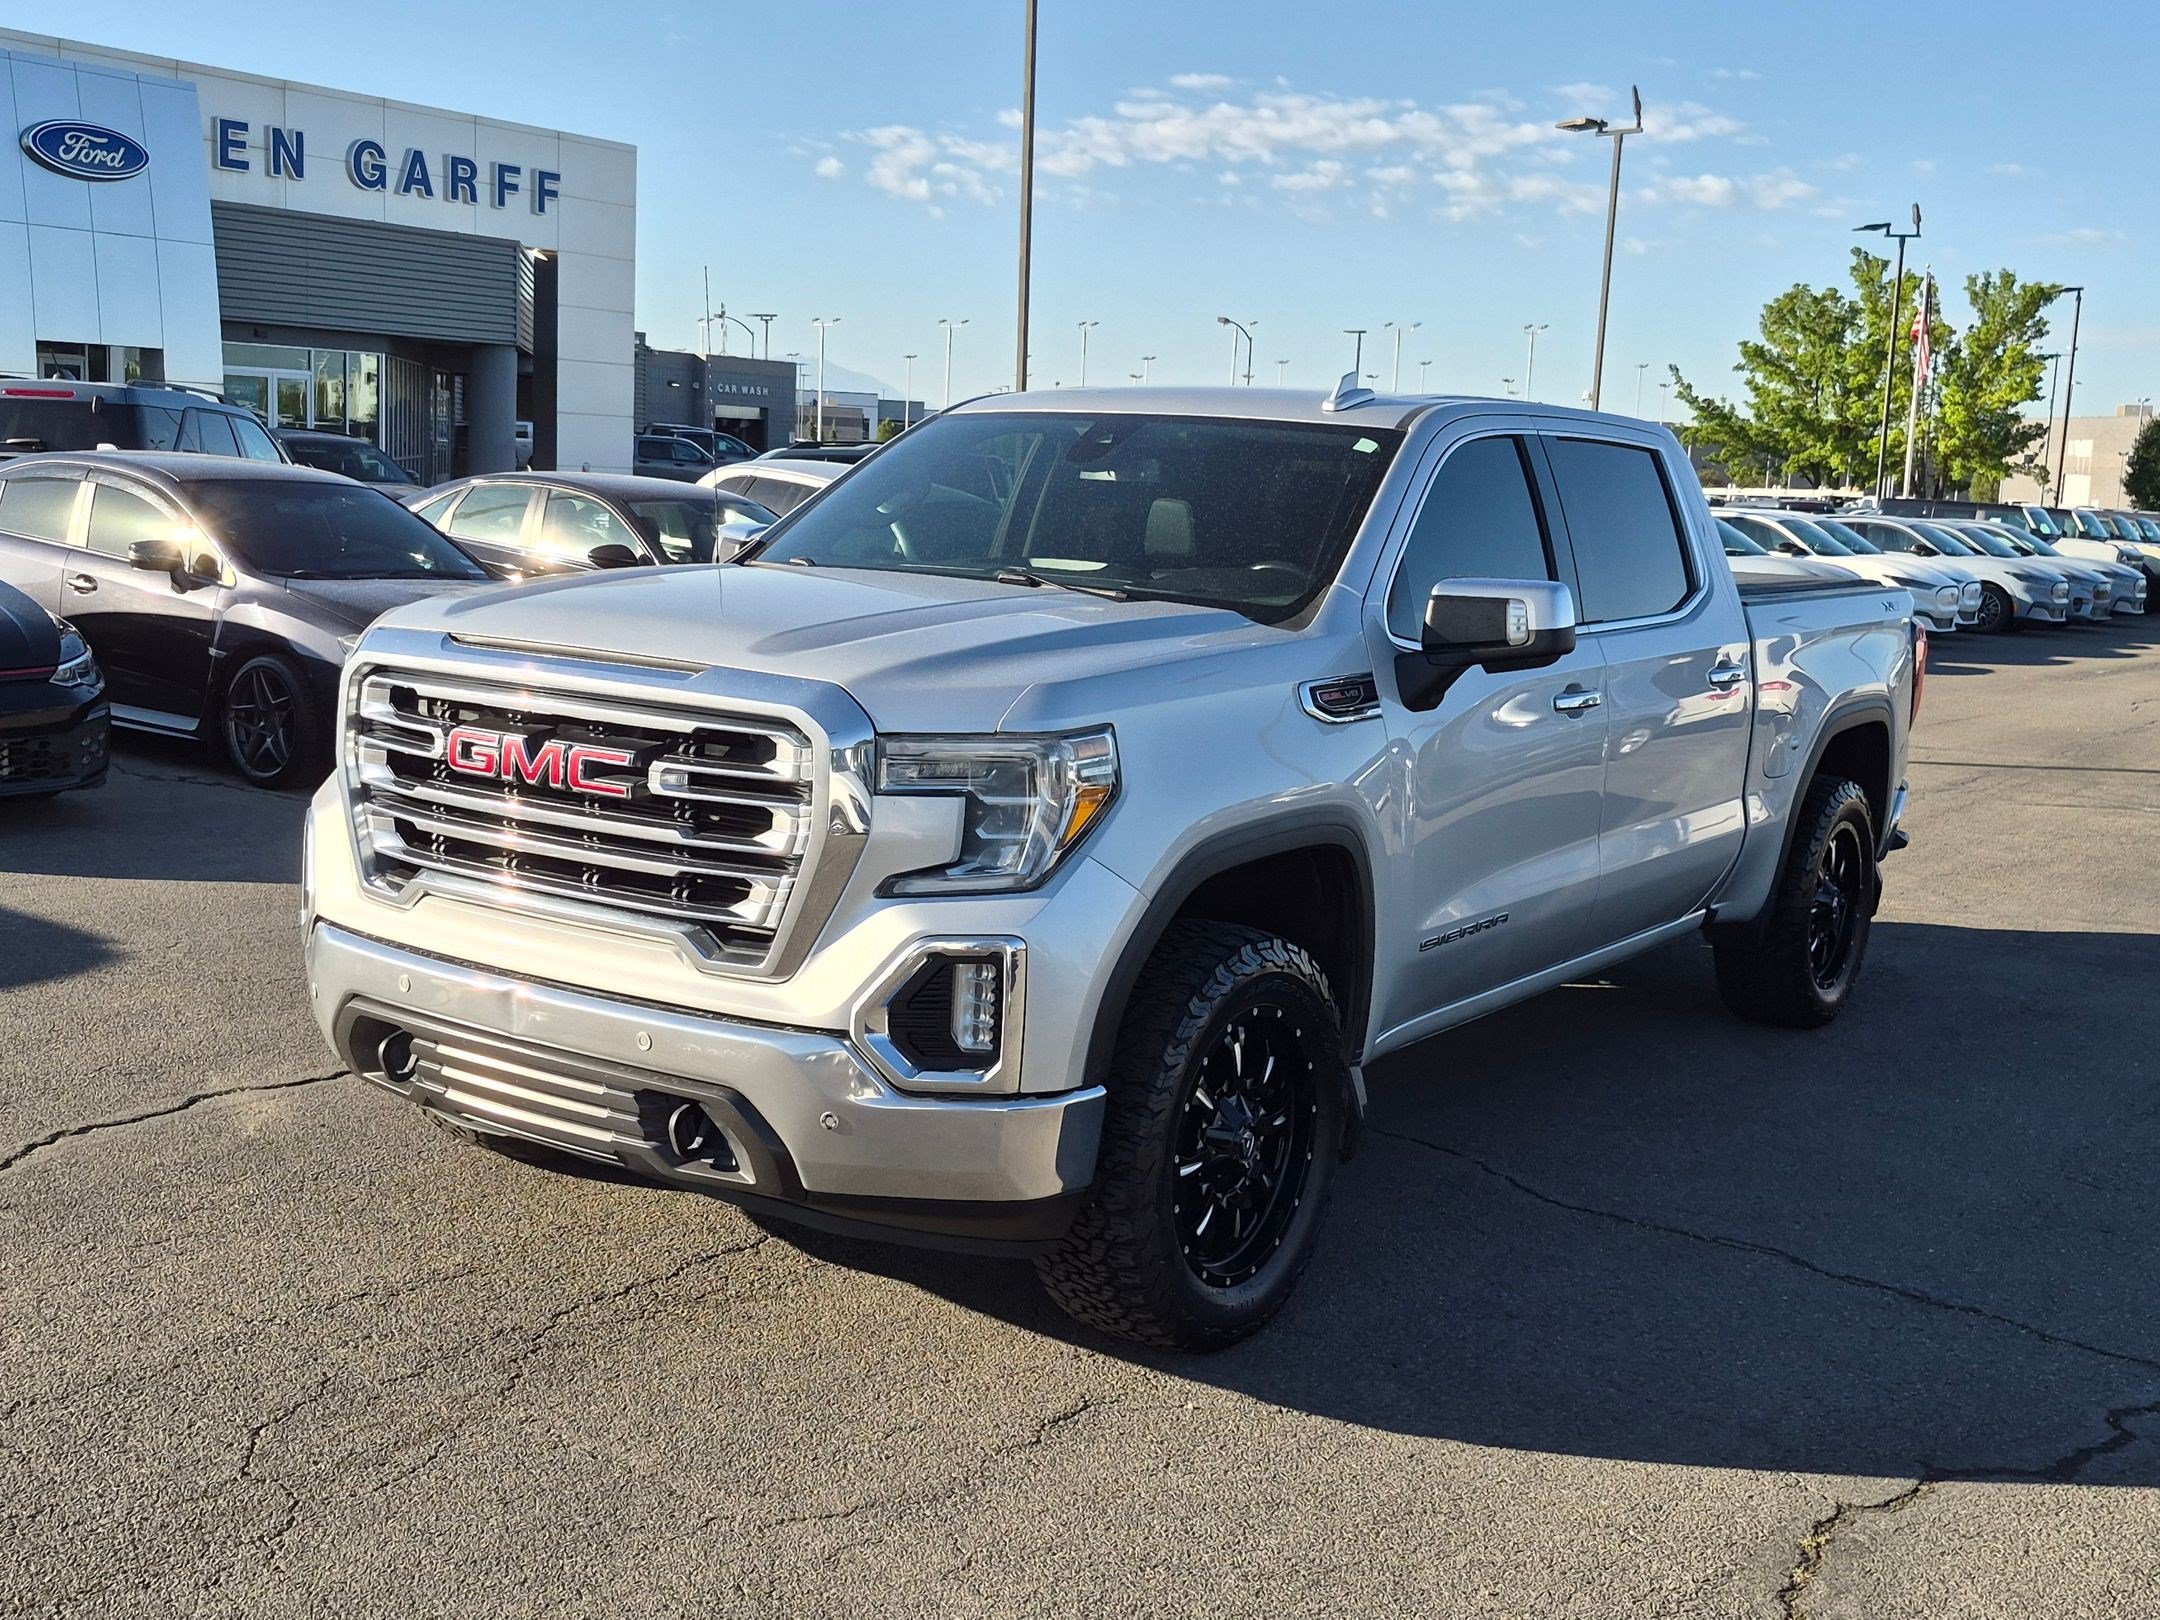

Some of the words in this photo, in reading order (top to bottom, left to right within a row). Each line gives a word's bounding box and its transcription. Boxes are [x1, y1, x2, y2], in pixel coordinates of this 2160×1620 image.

[58, 131, 126, 168] Ford
[213, 116, 304, 181] EN
[346, 138, 562, 215] GARFF
[717, 383, 737, 394] CAR
[741, 385, 769, 396] WASH
[448, 726, 635, 800] GMC
[1419, 912, 1509, 952] SIERRA
